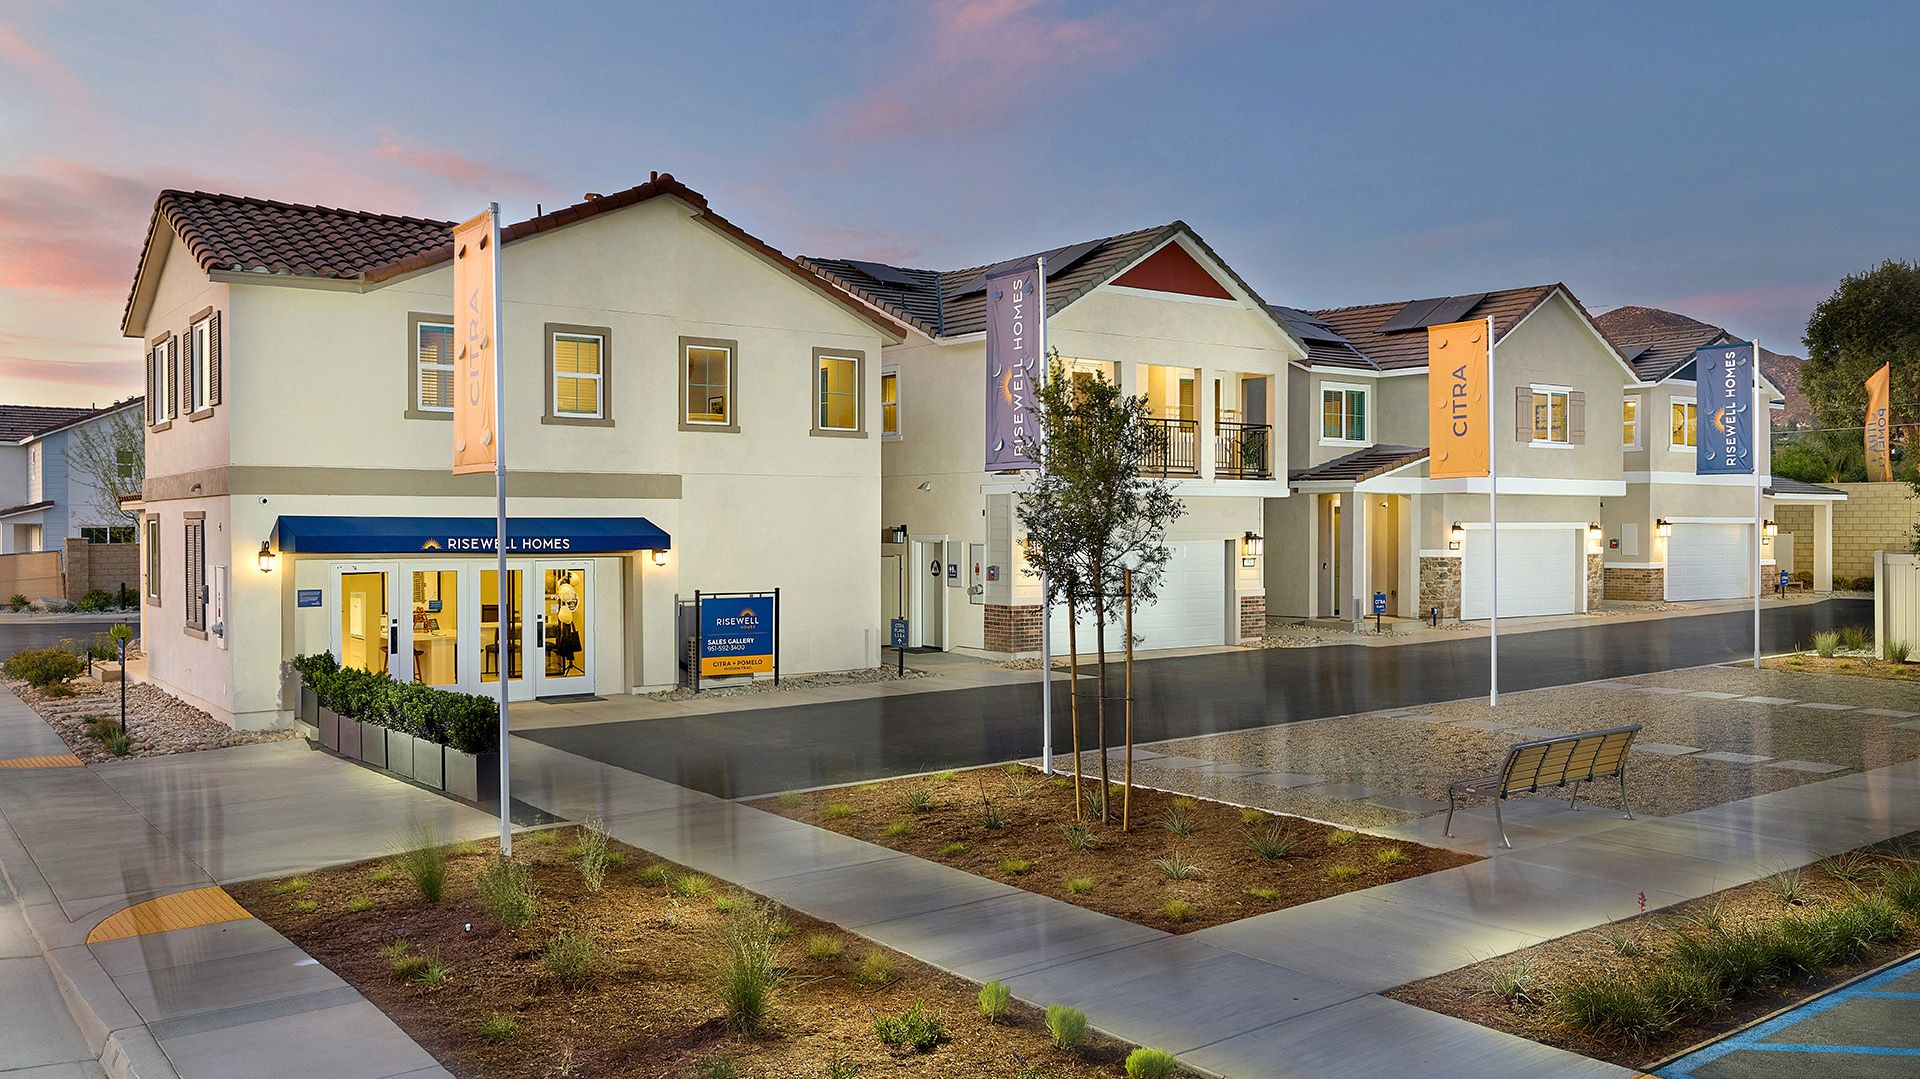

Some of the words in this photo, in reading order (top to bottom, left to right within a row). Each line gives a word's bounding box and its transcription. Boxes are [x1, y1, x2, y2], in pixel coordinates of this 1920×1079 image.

[469, 289, 480, 406] CITRA
[1013, 279, 1023, 350] HOMES
[1013, 358, 1024, 457] RISEWELL
[1452, 364, 1468, 437] CITRA
[1725, 351, 1736, 397] HOMES
[1725, 402, 1736, 466] RISEWELL
[447, 538, 517, 549] RISEWEL
[522, 538, 570, 549] HOMES
[716, 617, 759, 626] RISEWELL
